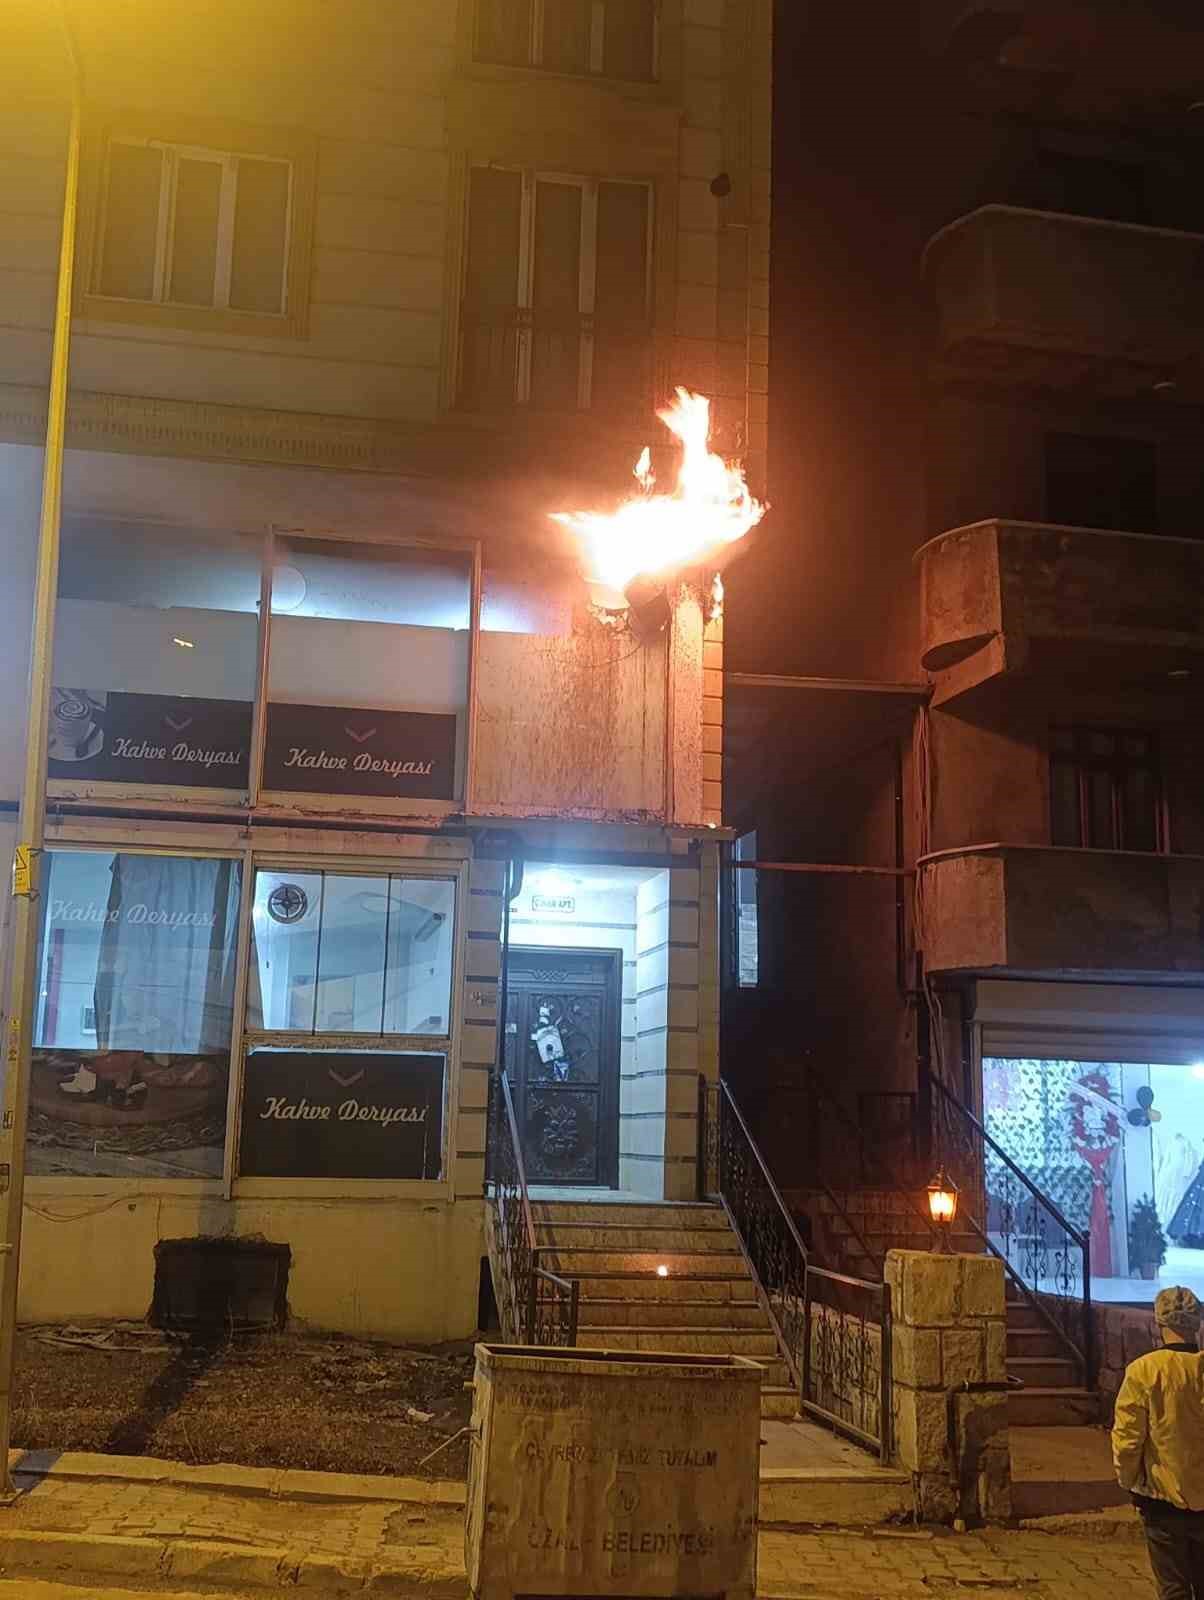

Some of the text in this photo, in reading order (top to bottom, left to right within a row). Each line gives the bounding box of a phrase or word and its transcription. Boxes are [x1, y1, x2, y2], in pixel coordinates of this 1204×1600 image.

[112, 737, 167, 760] Kahve
[284, 748, 348, 770] Kahve
[259, 1097, 331, 1120] Kahve
